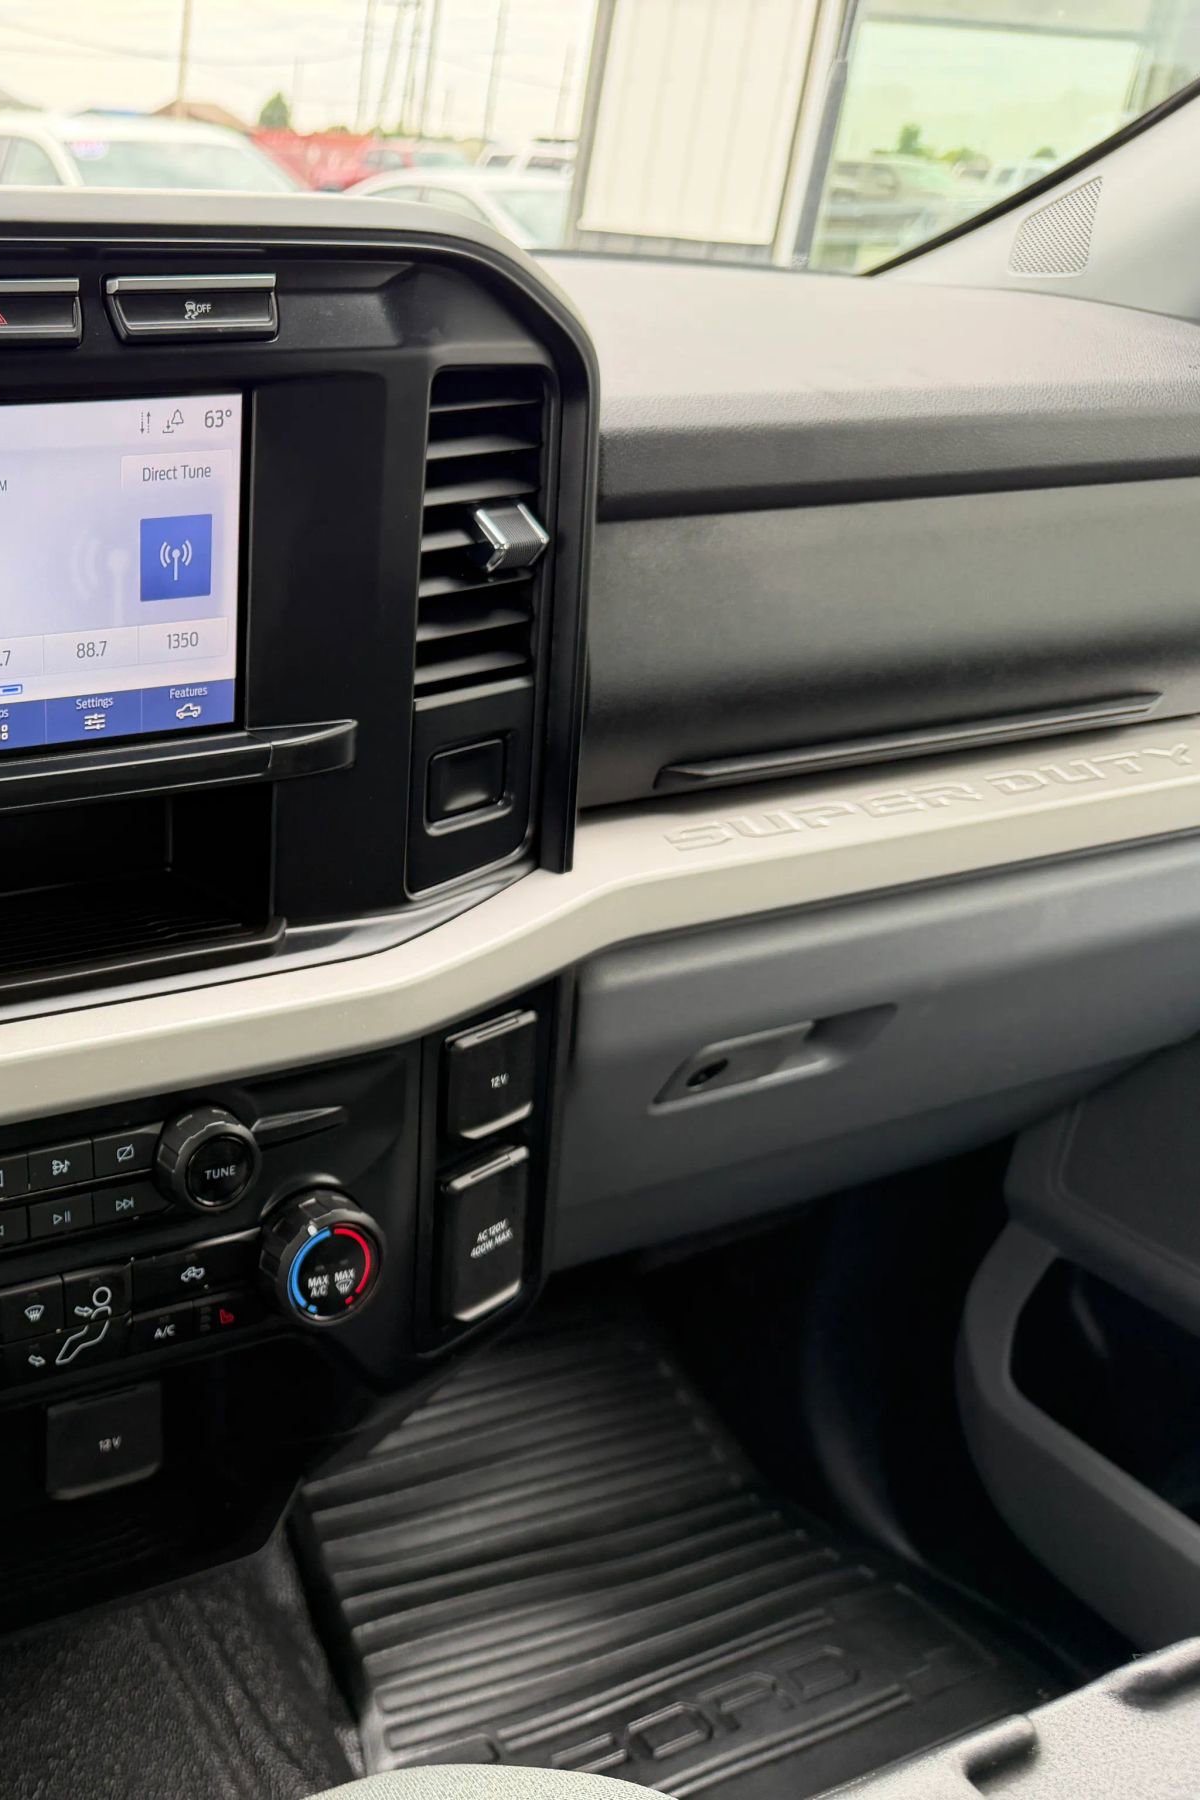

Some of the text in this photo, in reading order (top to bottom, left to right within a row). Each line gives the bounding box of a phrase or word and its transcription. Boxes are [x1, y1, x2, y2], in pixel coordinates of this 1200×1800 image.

[196, 303, 212, 314] OFF
[204, 409, 233, 429] 63°
[142, 463, 212, 483] Direct Tune
[166, 630, 199, 650] 1350
[76, 640, 108, 660] 88.7
[168, 685, 209, 700] Features
[75, 694, 114, 712] Settings
[663, 744, 1192, 852] SUPER DUTY
[204, 1164, 237, 1180] TUNE
[476, 1217, 510, 1243] AC 120V
[470, 1227, 514, 1259] 400W MAX
[307, 1273, 329, 1289] MAX
[334, 1267, 355, 1282] MAX
[310, 1284, 328, 1298] A/C
[154, 1324, 177, 1340] A/C
